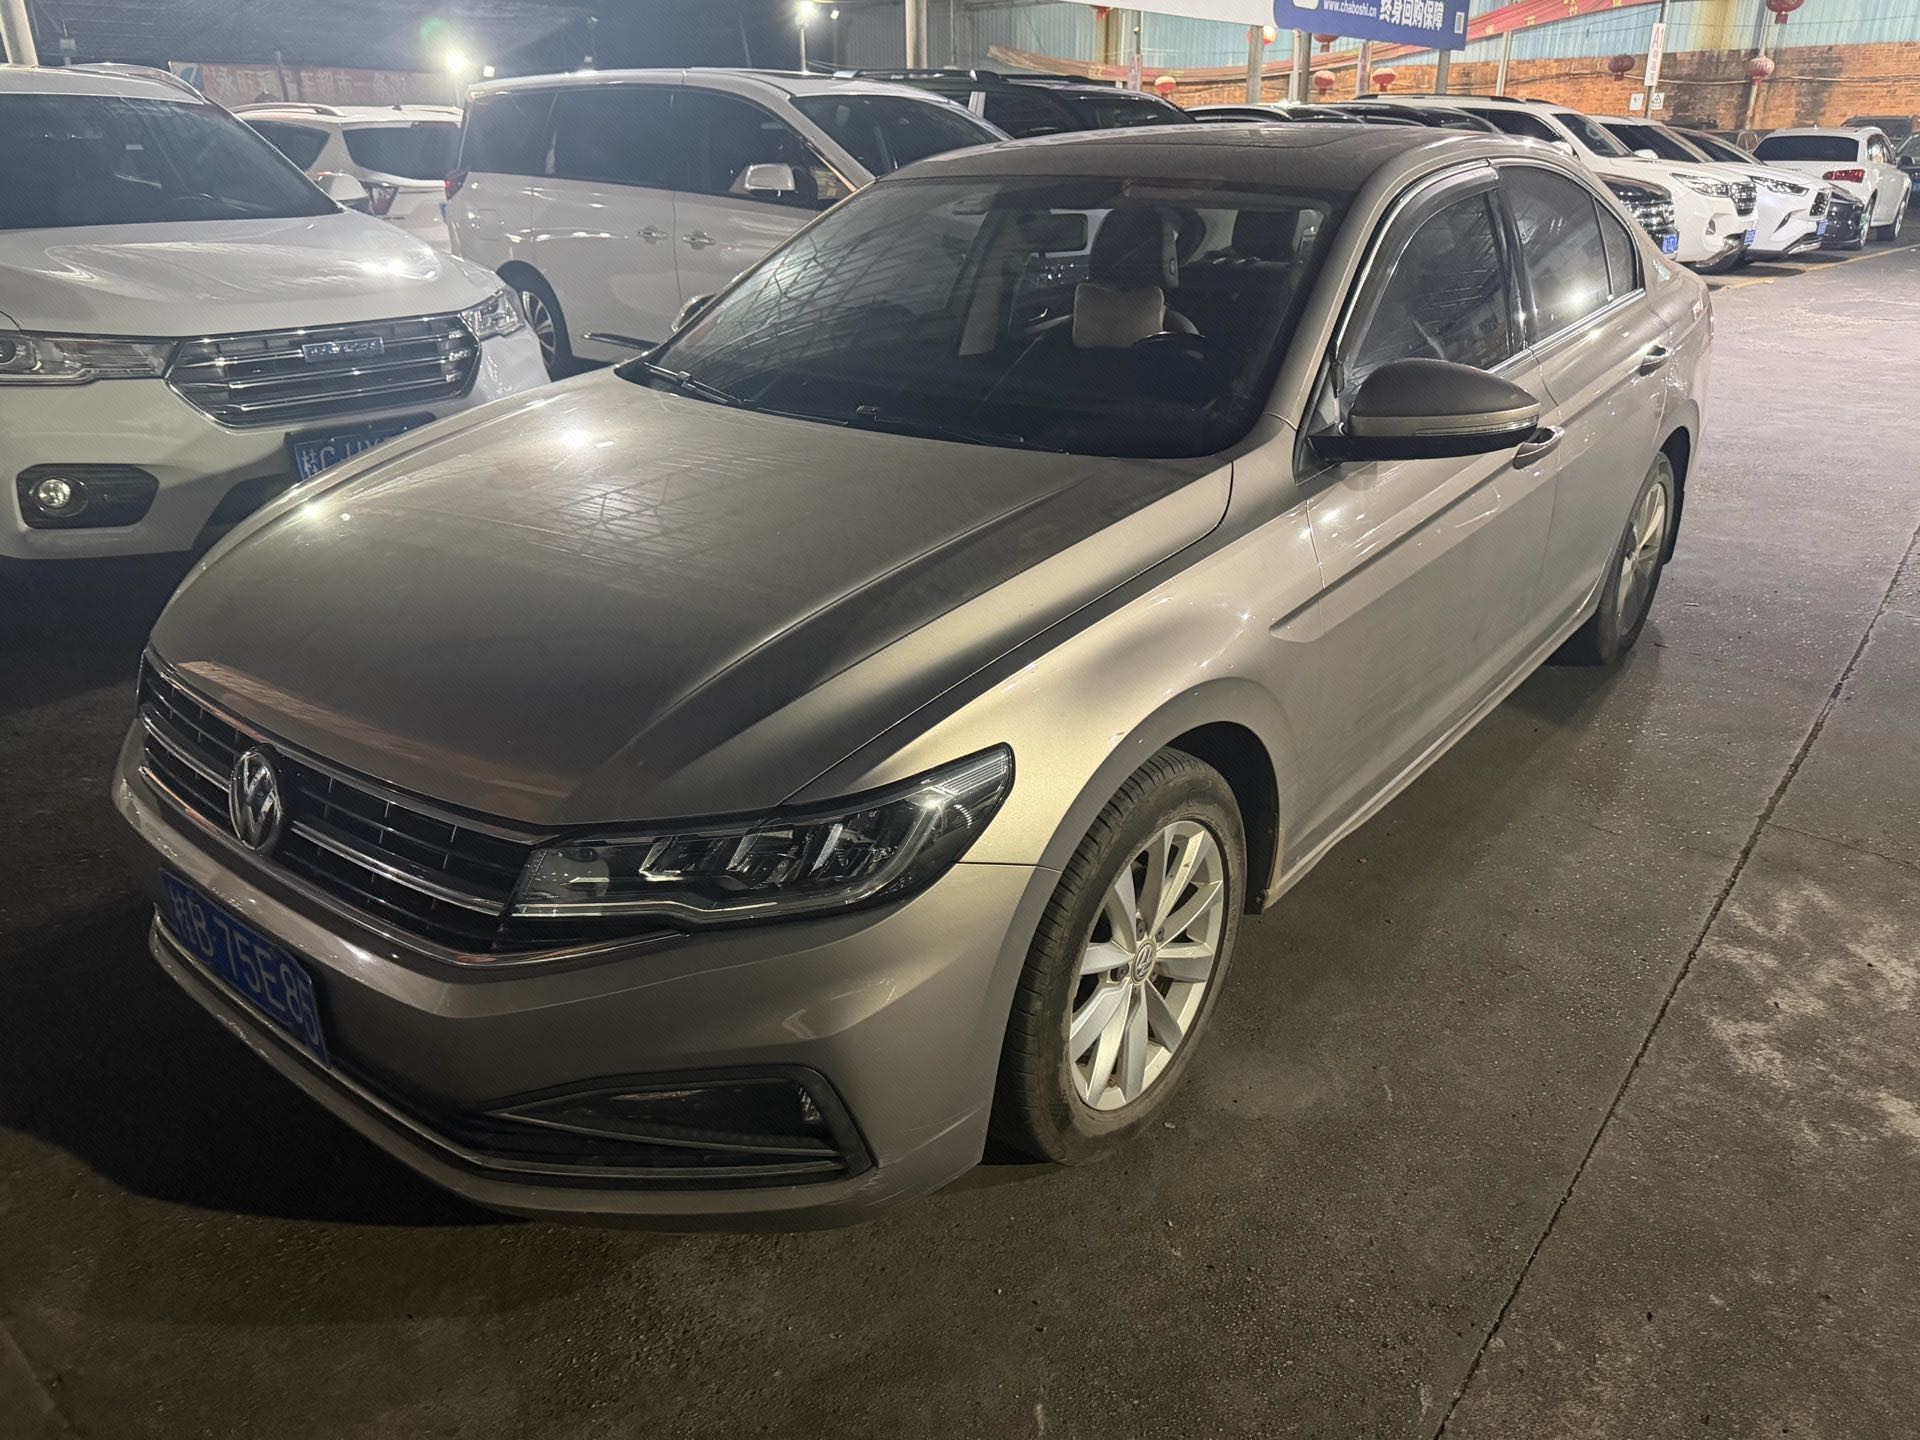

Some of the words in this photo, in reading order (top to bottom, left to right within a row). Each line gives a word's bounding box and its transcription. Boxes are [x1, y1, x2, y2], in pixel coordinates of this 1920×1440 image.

[1323, 0, 1377, 17] www.chaboshi.cn
[1379, 0, 1444, 31] 终身回购保障
